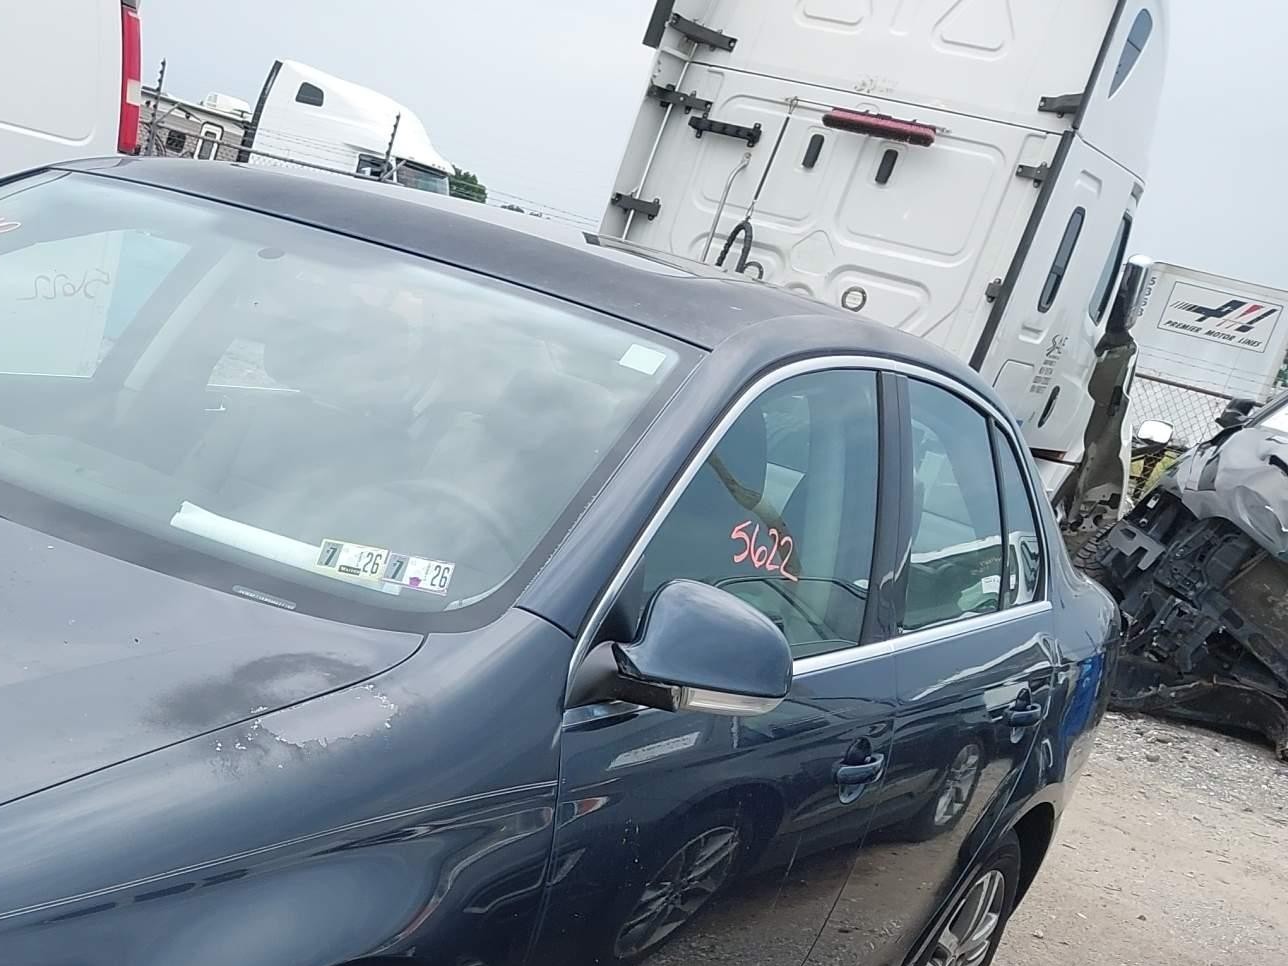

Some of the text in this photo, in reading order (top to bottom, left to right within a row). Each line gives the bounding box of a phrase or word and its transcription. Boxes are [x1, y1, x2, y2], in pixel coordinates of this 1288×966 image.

[1163, 319, 1263, 348] PREMIER MOTOR LINES
[323, 546, 338, 566] 7
[362, 551, 383, 575] 26
[730, 520, 799, 582] 5622
[391, 559, 404, 580] 7
[429, 564, 451, 589] 26
